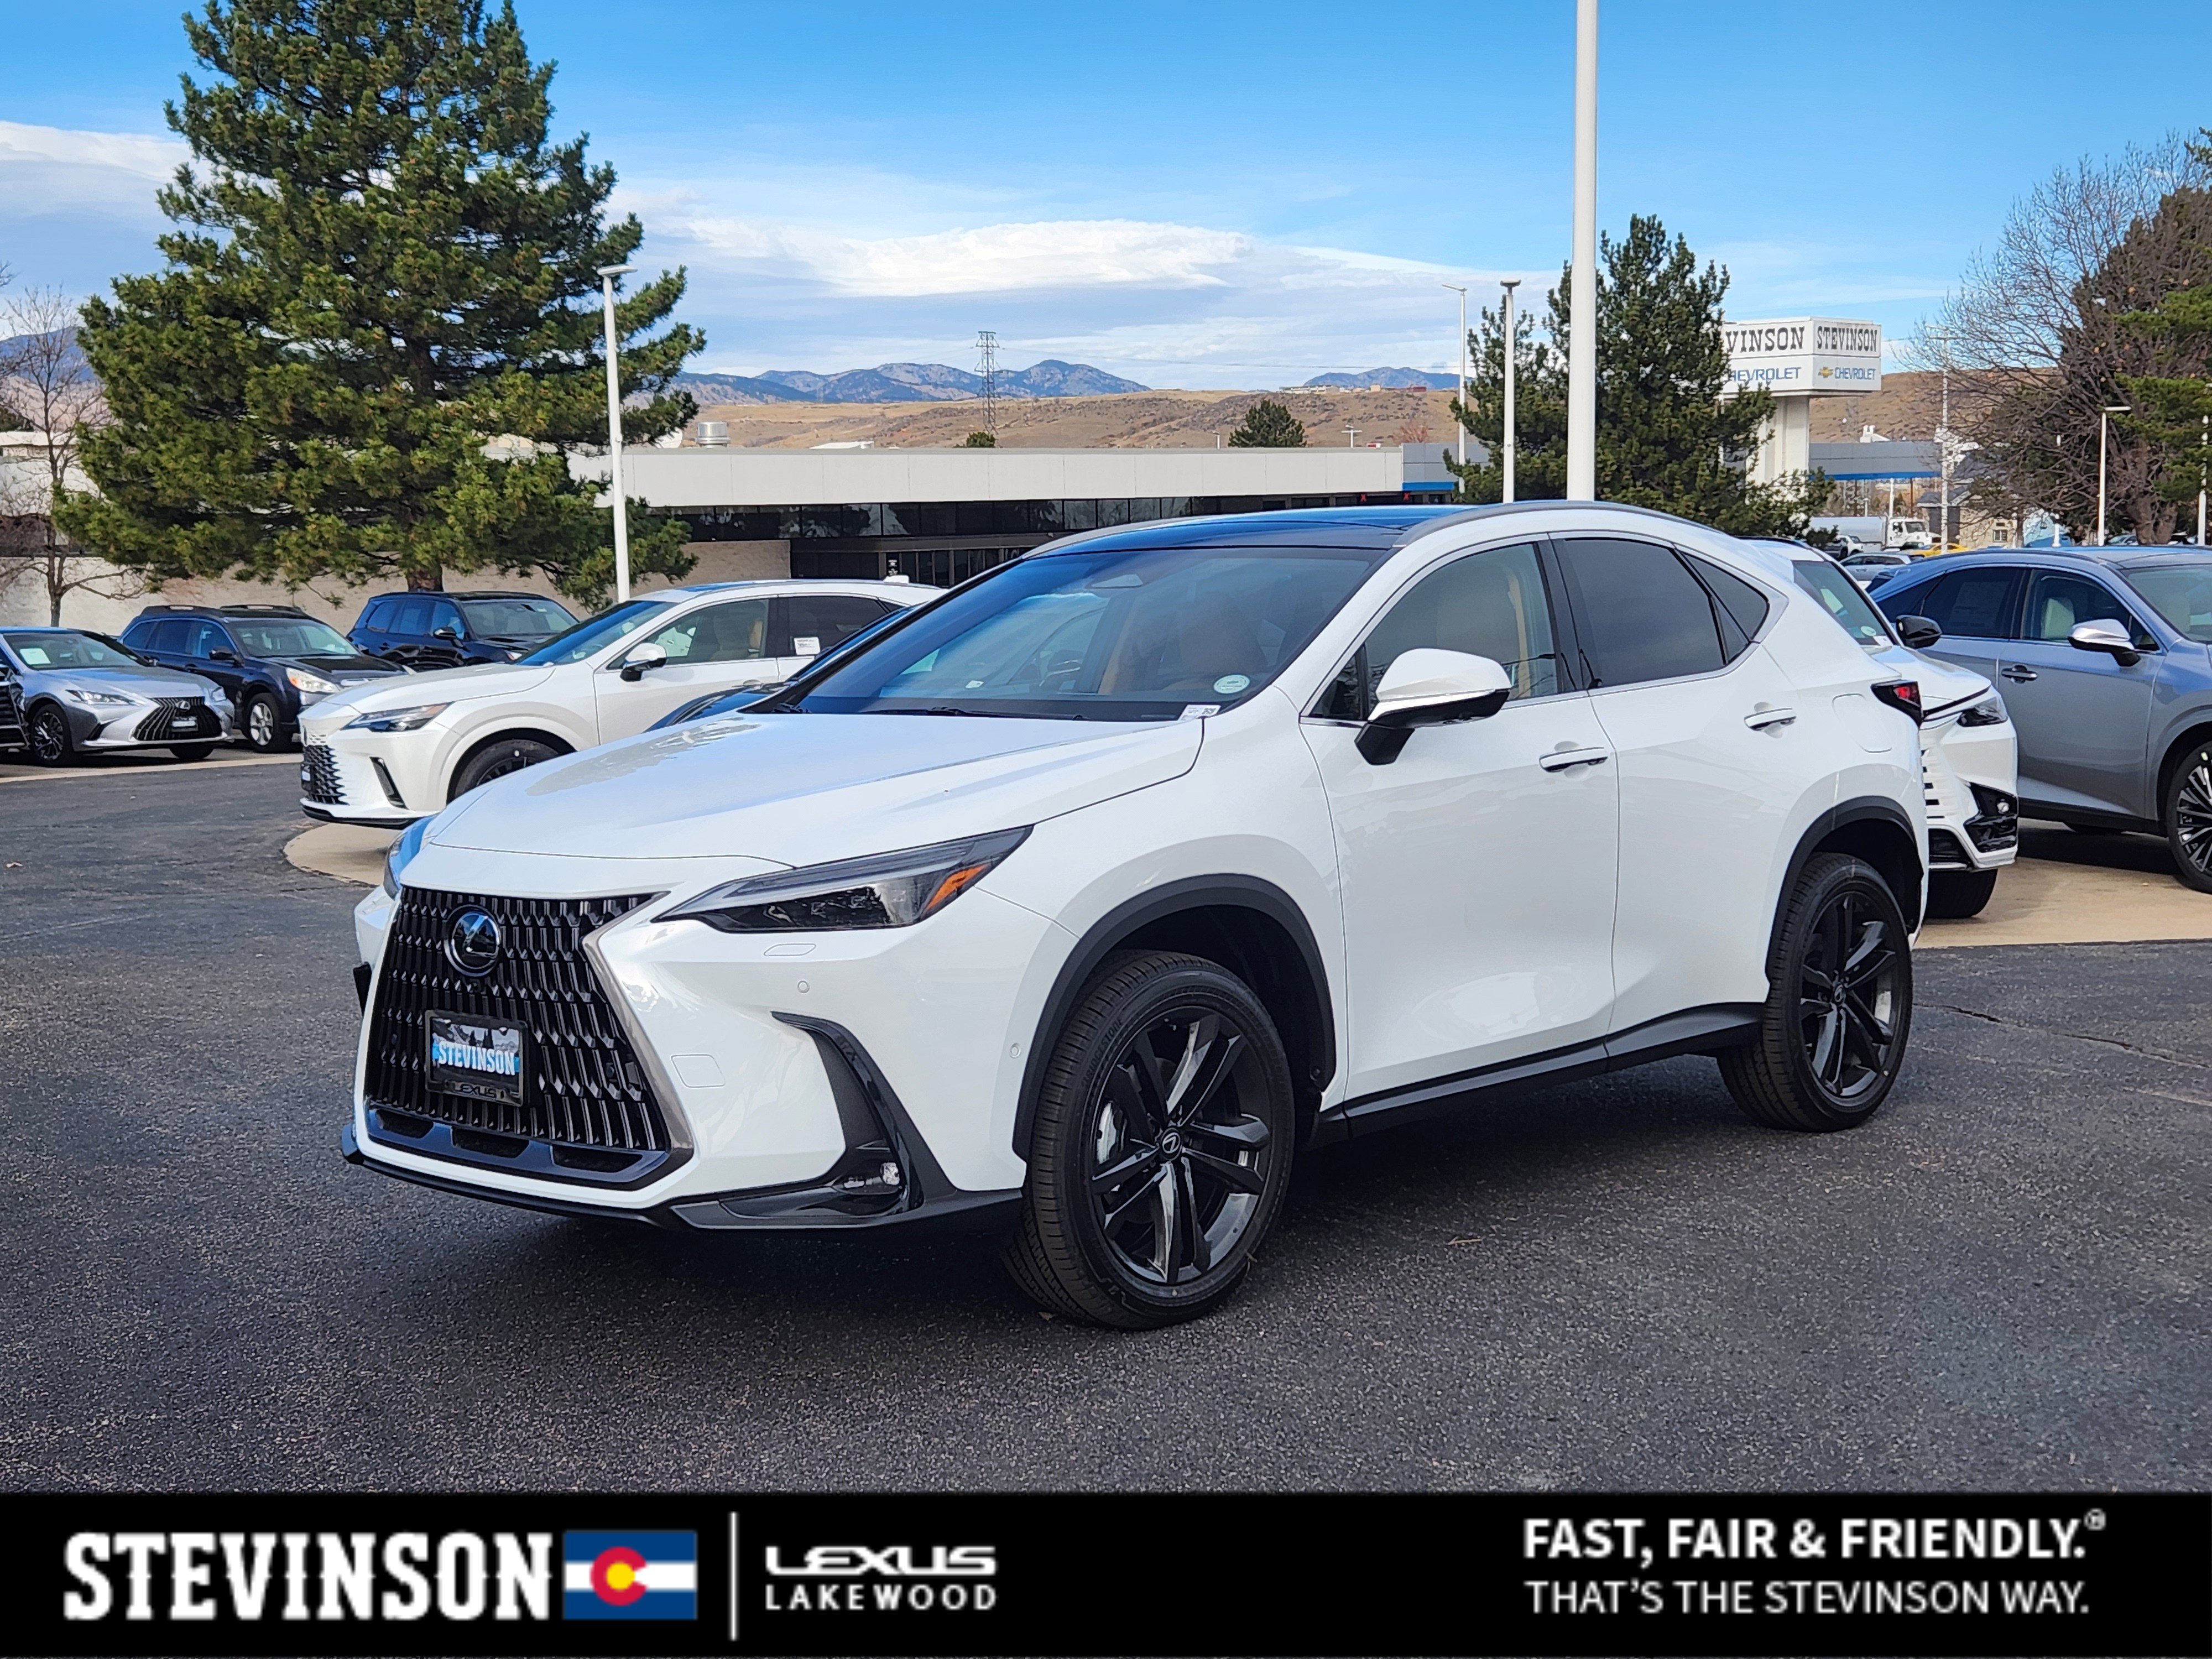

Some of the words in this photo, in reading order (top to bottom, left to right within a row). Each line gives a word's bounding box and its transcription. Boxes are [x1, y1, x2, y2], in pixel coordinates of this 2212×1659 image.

[1817, 326, 1877, 352] STEVINSON
[1834, 367, 1876, 380] CHEVROLET
[438, 1041, 515, 1076] STEVINSON
